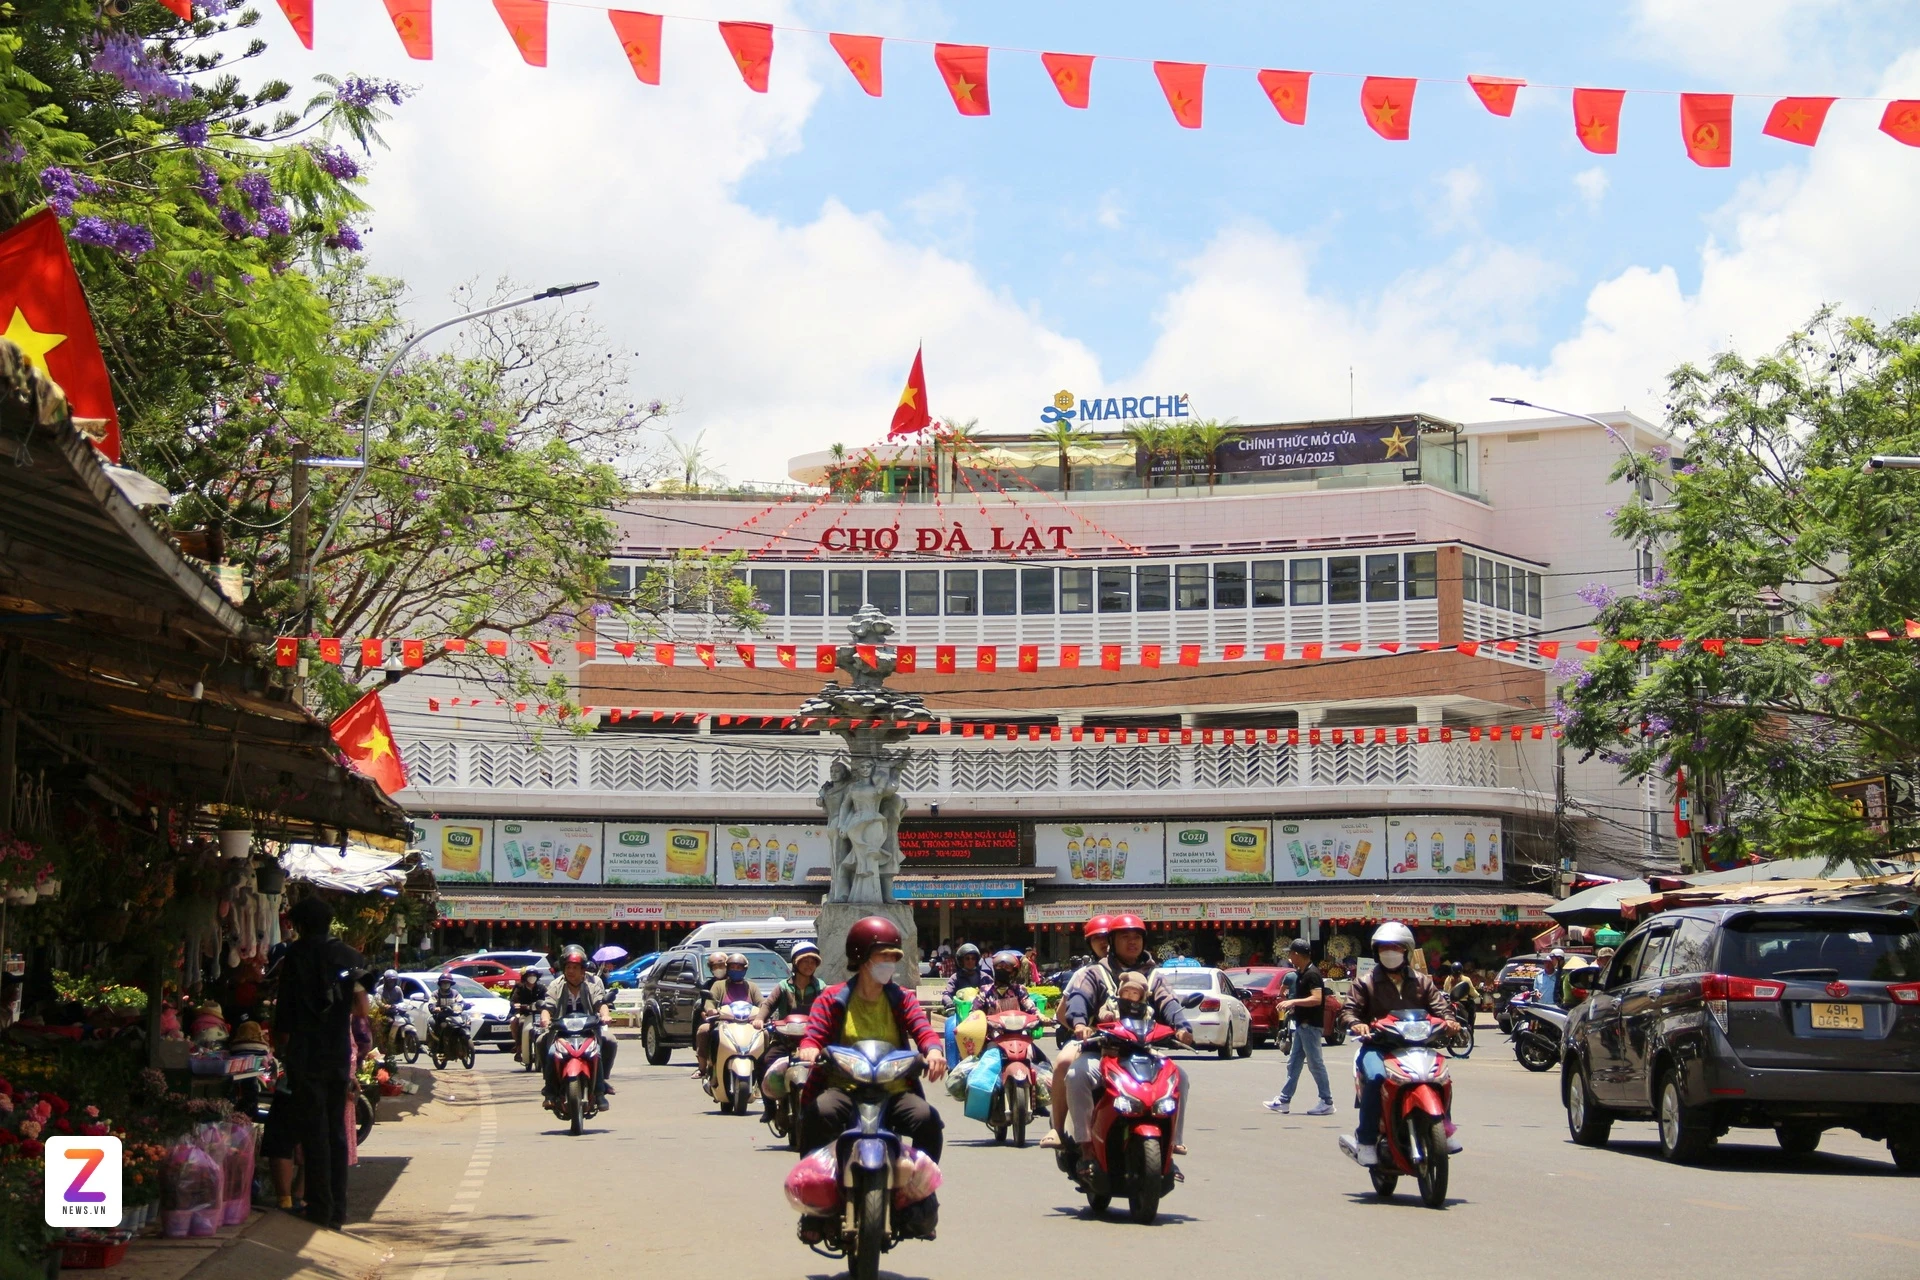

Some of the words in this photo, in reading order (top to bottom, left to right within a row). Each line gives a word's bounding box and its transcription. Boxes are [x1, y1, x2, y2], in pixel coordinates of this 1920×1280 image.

[1238, 434, 1275, 451] CHÍNH
[1276, 433, 1308, 449] THỨC
[1311, 432, 1330, 447] MỞ
[1332, 431, 1356, 445] CỬA
[1260, 452, 1277, 466] TỪ
[1278, 452, 1335, 465] 30/4/2025
[821, 522, 900, 556] CHỢ
[916, 522, 973, 551] ĐÀ
[990, 526, 1073, 555] LẠT
[450, 833, 471, 845] Cozy
[622, 832, 647, 844] Cozy
[674, 836, 697, 848] Cozy
[1181, 831, 1206, 843] Cozy
[1232, 834, 1254, 846] Cozy
[1826, 1005, 1848, 1015] 49H
